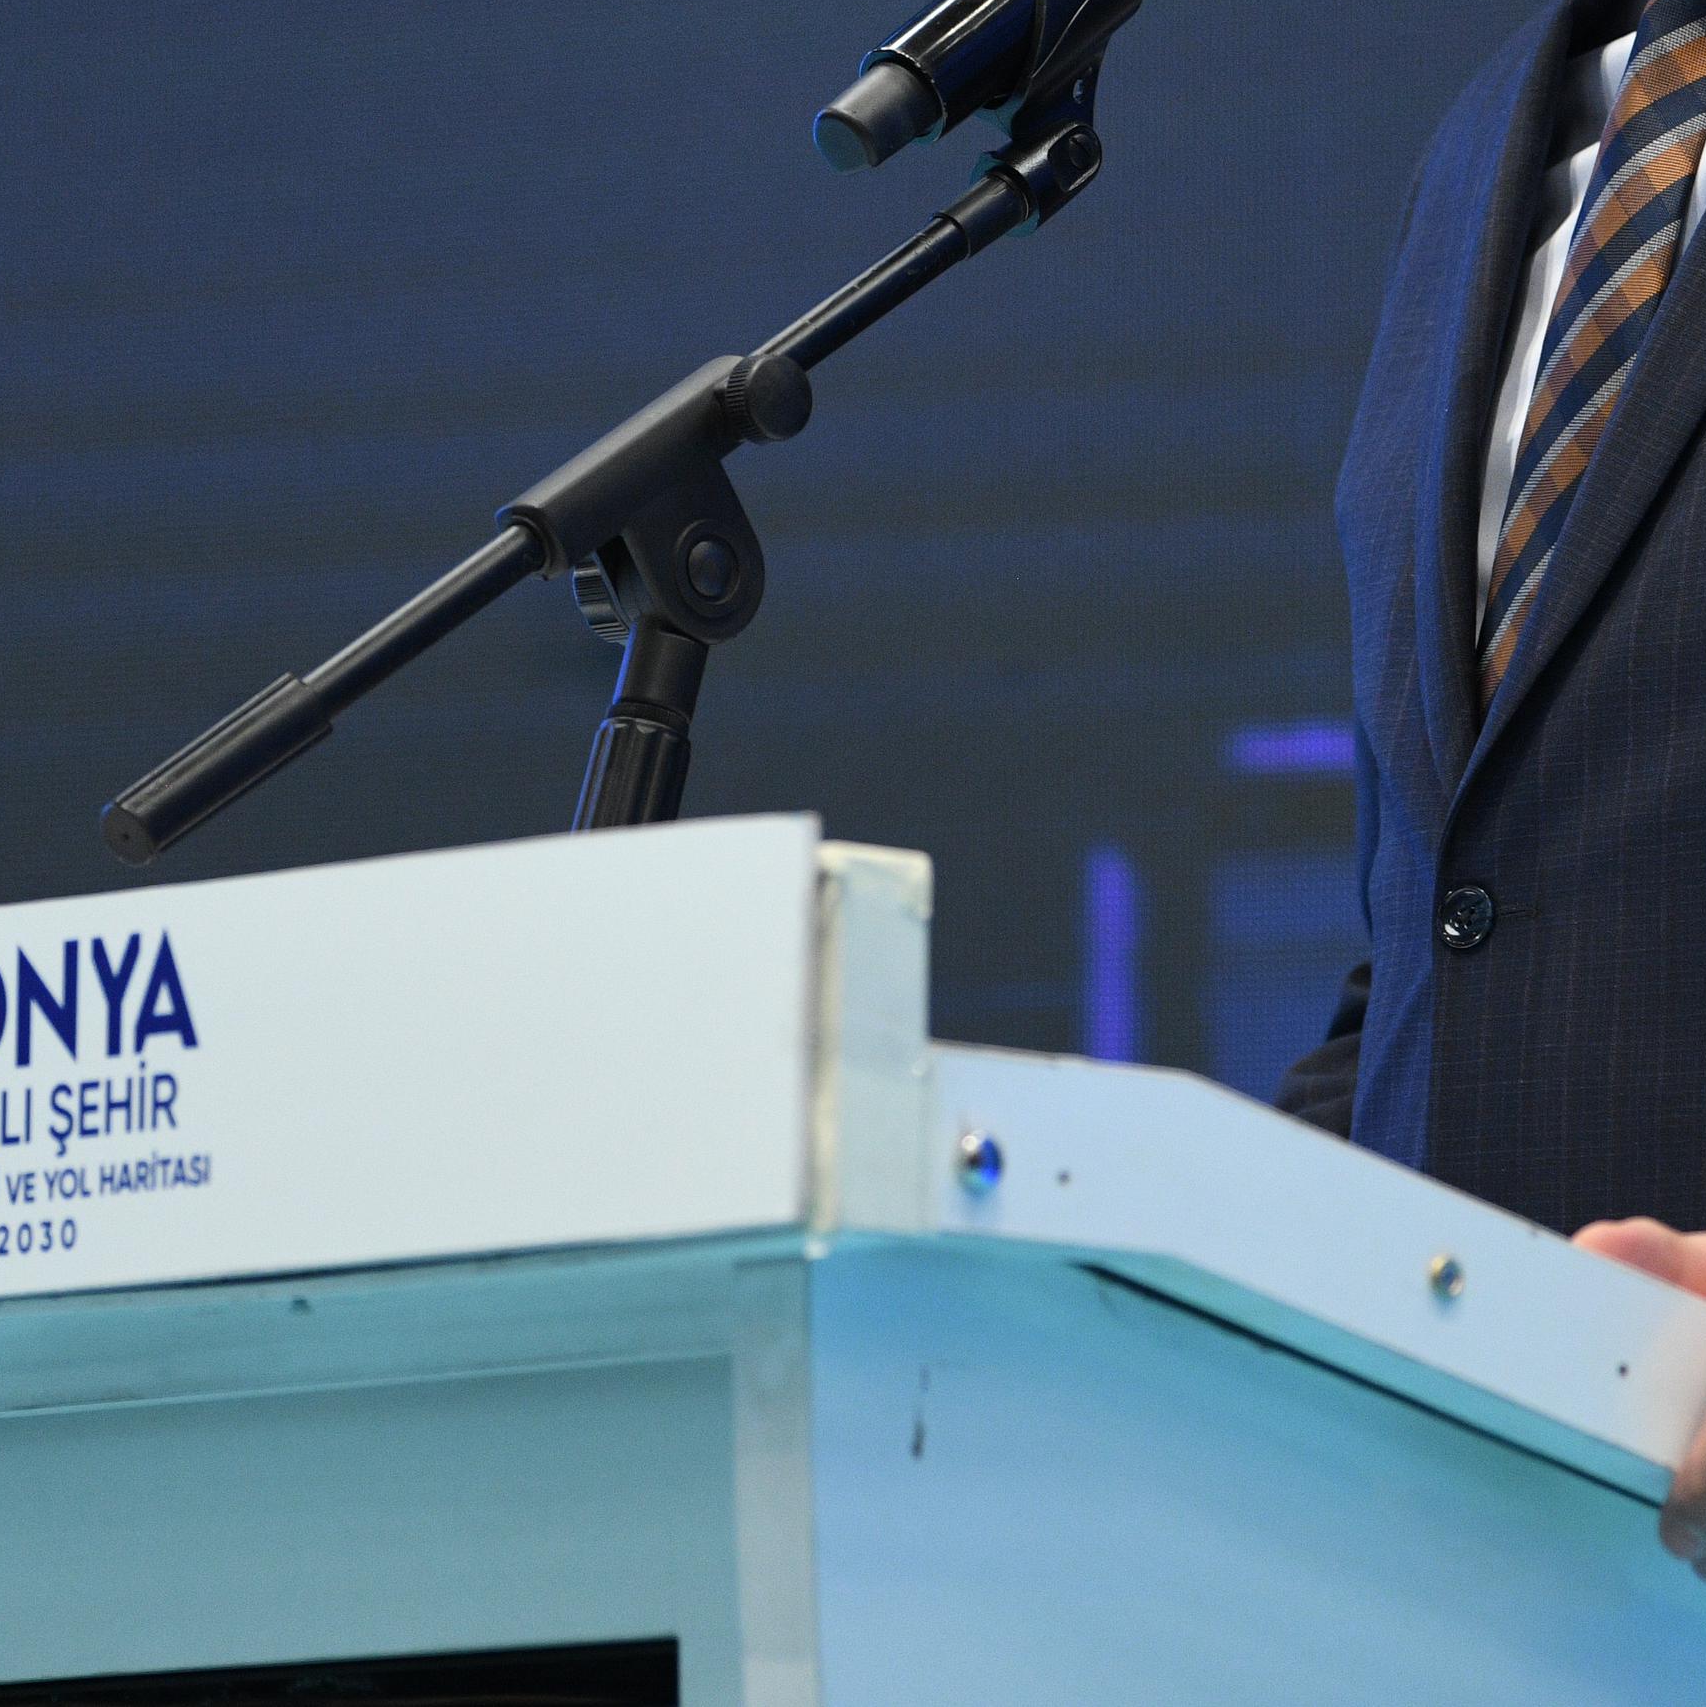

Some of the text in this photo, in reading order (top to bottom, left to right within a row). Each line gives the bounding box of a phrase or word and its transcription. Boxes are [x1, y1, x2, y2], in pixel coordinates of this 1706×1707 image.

[48, 1060, 179, 1158] ŞEHİR
[5, 1171, 36, 1206] VE
[43, 1167, 92, 1201] YOL
[99, 1152, 212, 1196] HARİTASI
